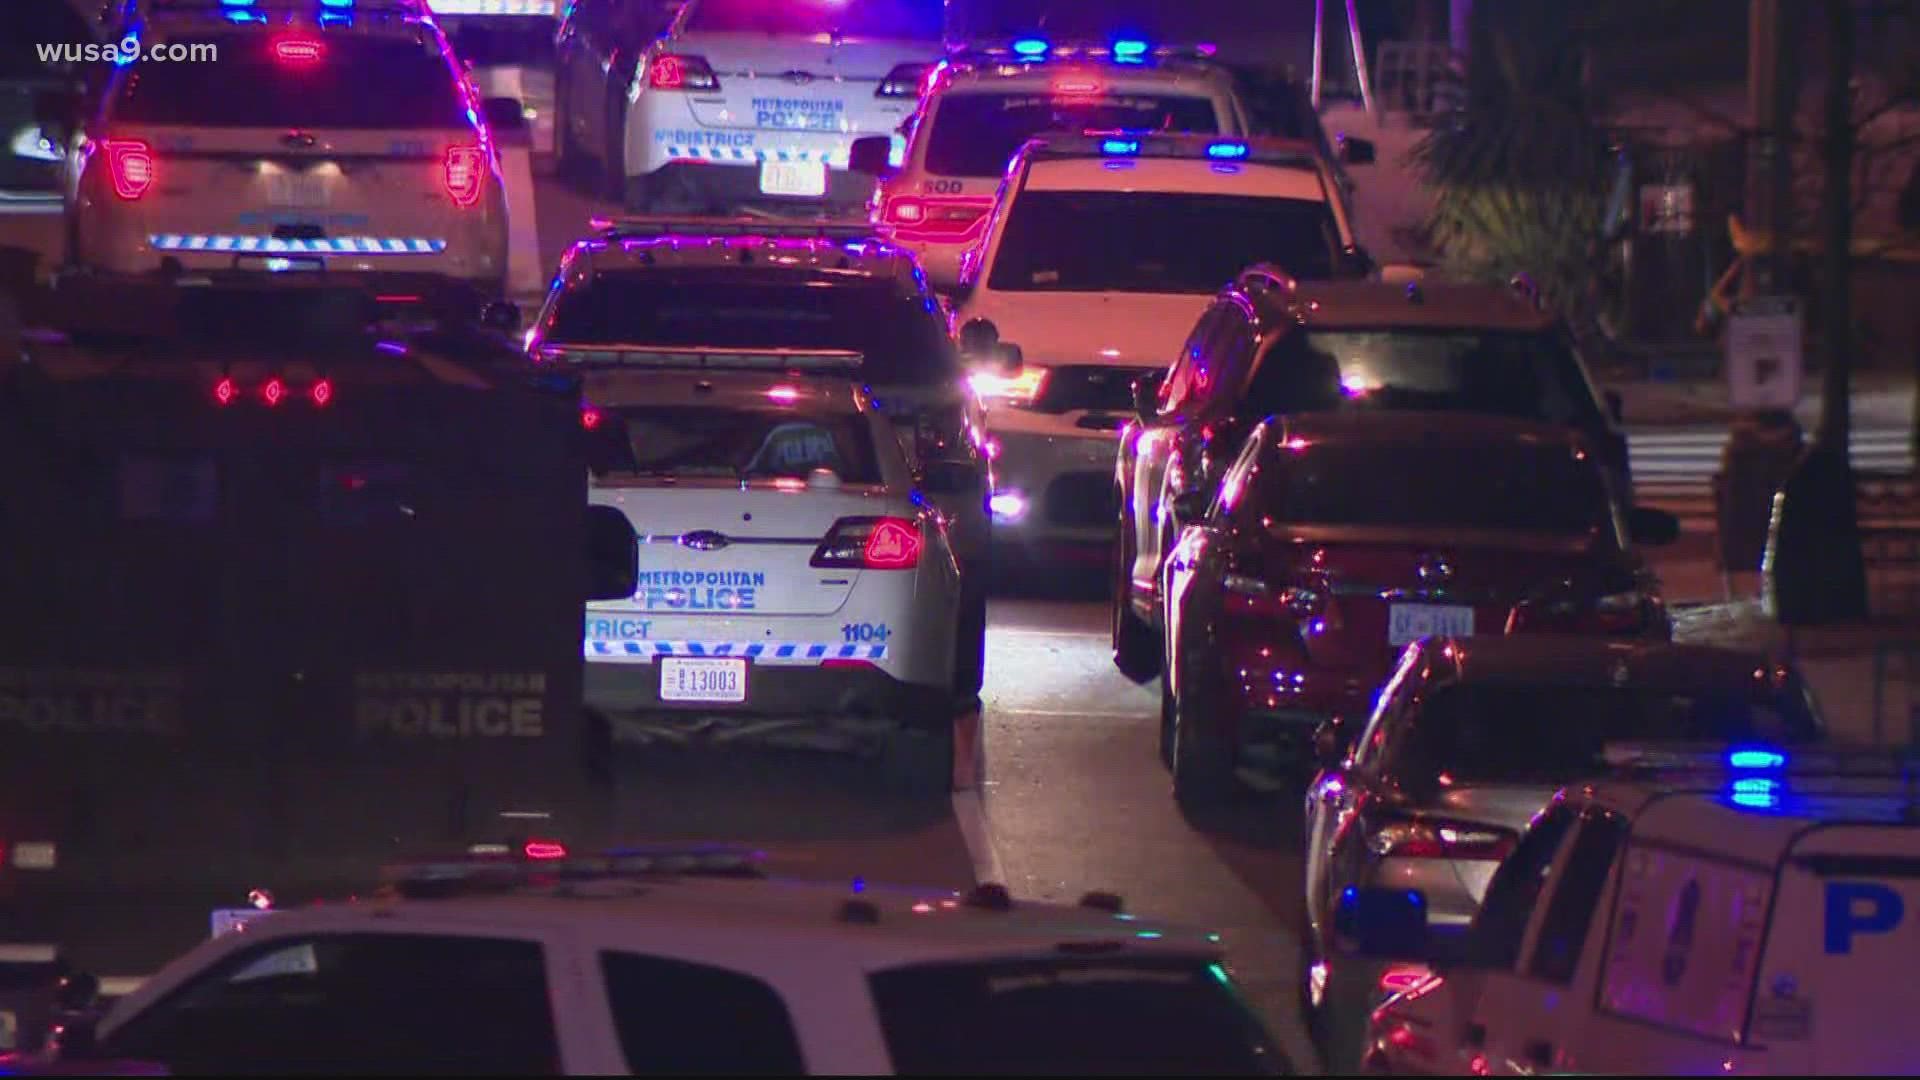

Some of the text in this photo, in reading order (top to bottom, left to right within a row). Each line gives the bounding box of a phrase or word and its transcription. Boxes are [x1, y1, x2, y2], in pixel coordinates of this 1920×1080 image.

[751, 98, 844, 112] METROPOLITAN
[756, 111, 835, 129] POCE
[640, 571, 765, 587] METROPOLITAN
[647, 588, 756, 609] POLICE
[841, 623, 887, 642] 1104
[691, 671, 737, 690] 13003
[355, 697, 545, 737] POLICE
[1824, 882, 1905, 956] P
